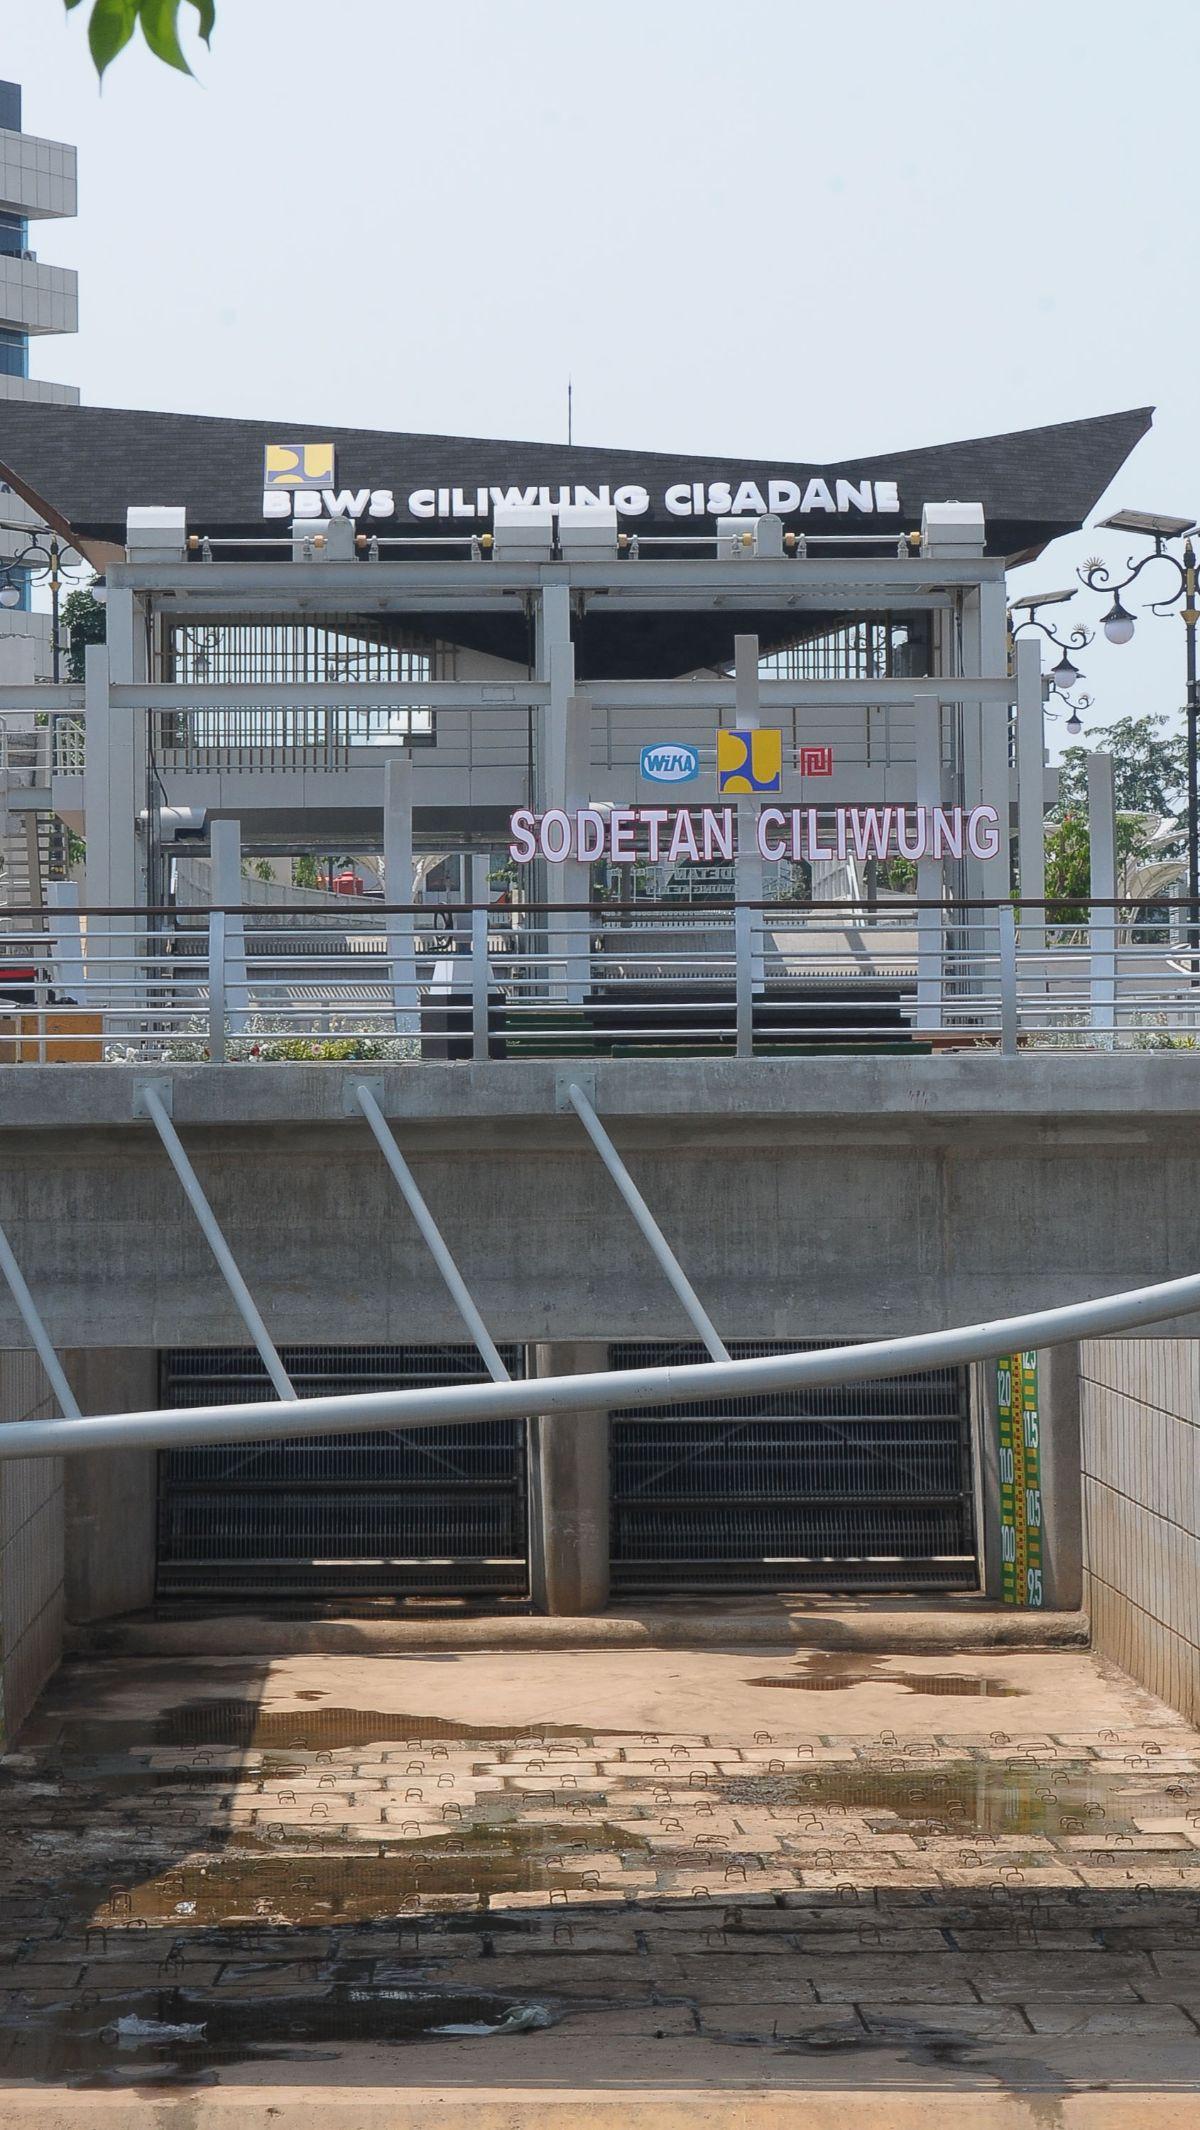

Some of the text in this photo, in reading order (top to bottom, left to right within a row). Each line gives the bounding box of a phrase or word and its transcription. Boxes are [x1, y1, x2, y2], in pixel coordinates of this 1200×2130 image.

[263, 478, 900, 518] BBWS CILIWUNG CISADANE
[510, 805, 1000, 863] SODETAN CILIWUNG
